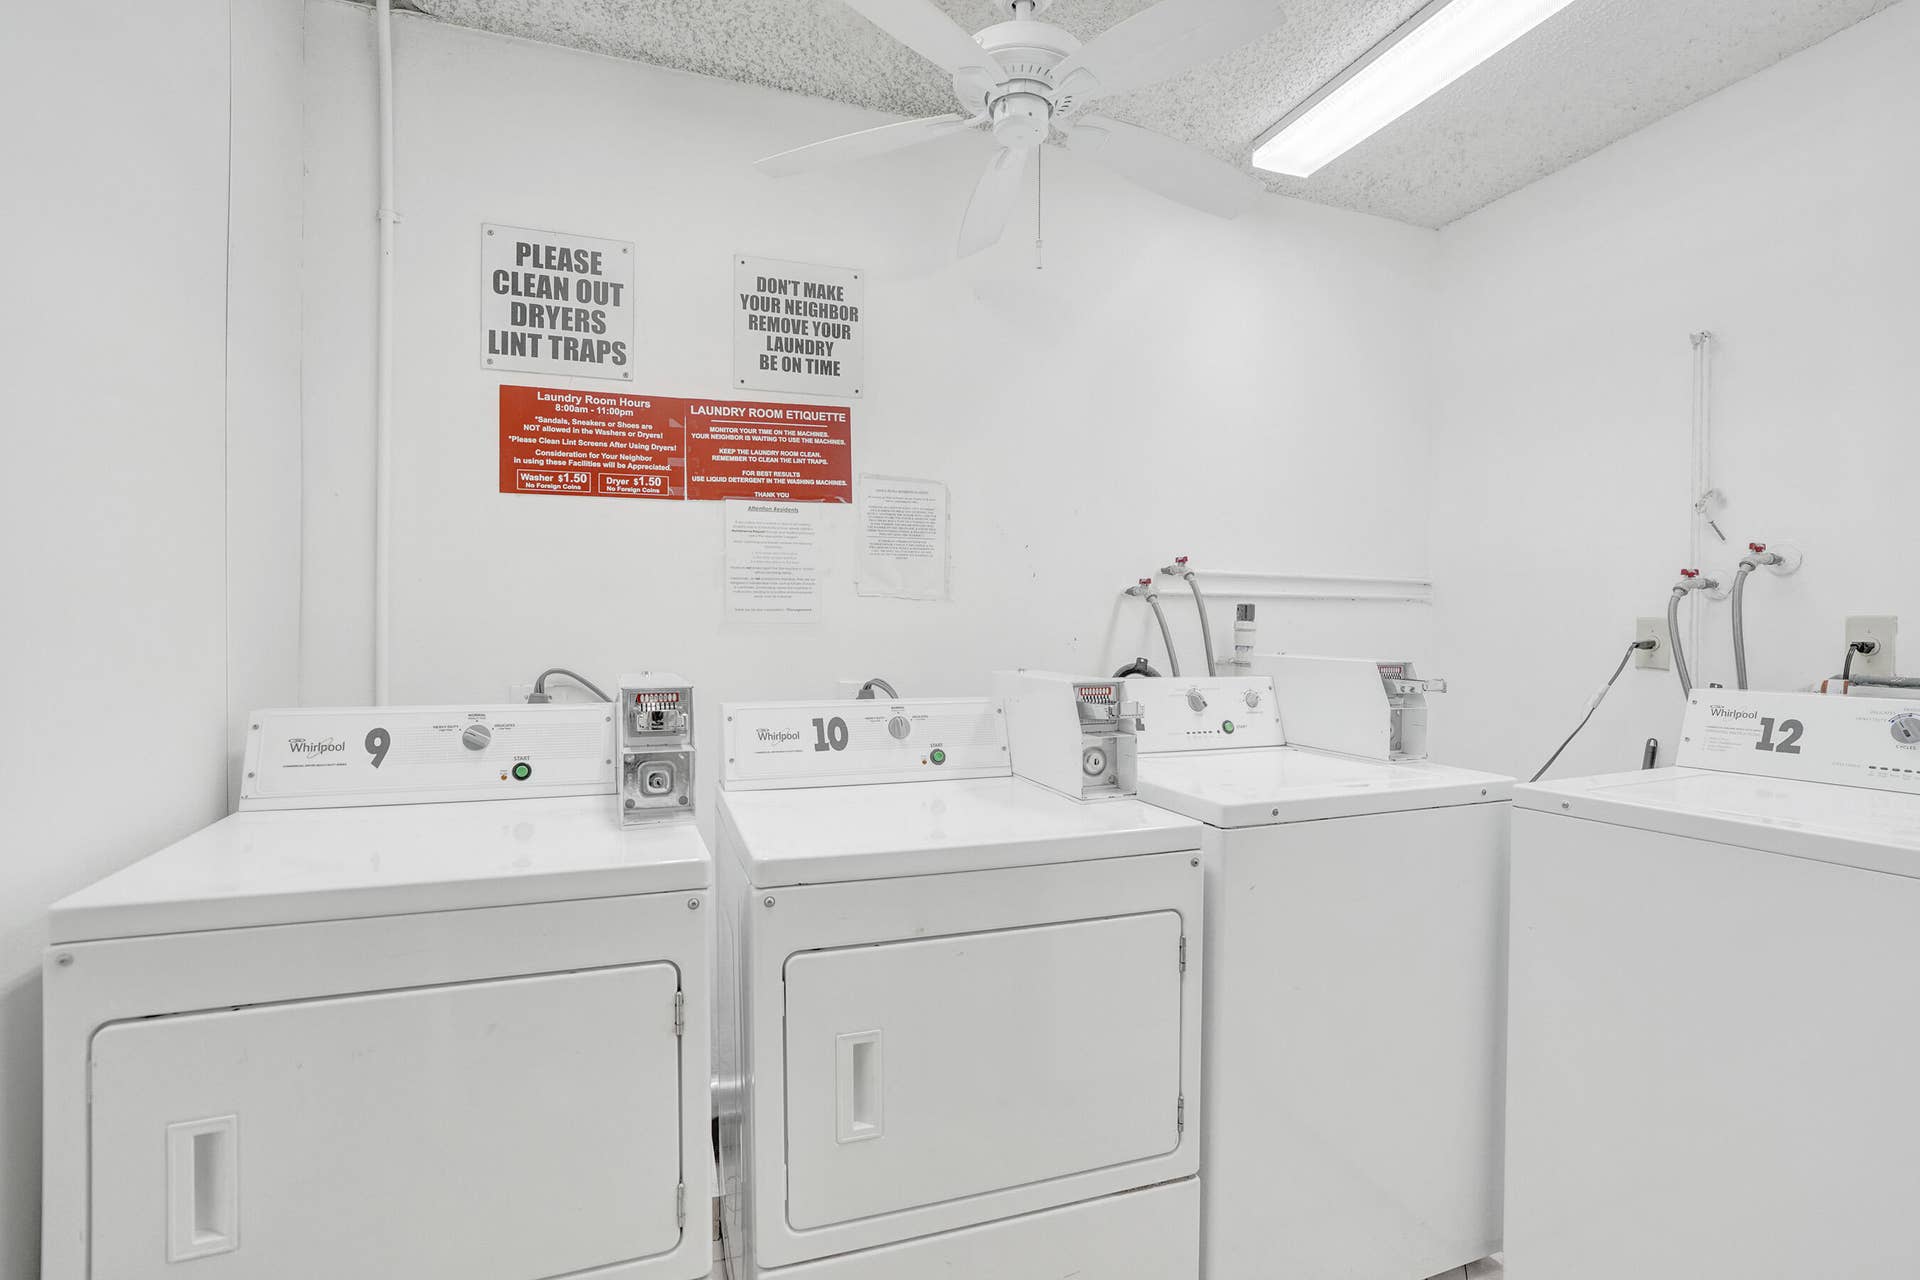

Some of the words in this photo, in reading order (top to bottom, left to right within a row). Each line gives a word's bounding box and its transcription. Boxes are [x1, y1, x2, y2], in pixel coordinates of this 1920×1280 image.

[516, 242, 602, 276] PLEASE
[492, 270, 569, 300] CLEAN
[576, 278, 624, 307] OUT
[756, 276, 800, 295] DON'T
[804, 283, 844, 301] MAKE
[740, 294, 781, 313] YOUR
[785, 298, 859, 322] NEIGHBOR
[511, 302, 606, 335] DRYERS
[748, 315, 809, 335] REMOVE
[813, 321, 851, 340] YOUR
[488, 329, 543, 358] LINT
[548, 335, 627, 366] TRAPS
[766, 335, 834, 357] LAUNDRY
[759, 355, 778, 371] BE
[781, 357, 802, 373] ON
[805, 357, 841, 377] TIME
[537, 392, 582, 405] Laundry
[585, 395, 616, 405] Room
[620, 398, 650, 408] Hours
[555, 404, 587, 413] 8:00am
[597, 407, 633, 416] 11:00pm
[691, 405, 746, 417] LAUNDRY
[749, 409, 783, 419] ROOM
[786, 411, 846, 422] ETIQUETTE
[542, 425, 570, 433] allowed
[637, 431, 663, 439] Dryers!
[572, 418, 606, 427] Sneakers
[618, 420, 639, 429] Shoes
[539, 437, 560, 445] Clean
[562, 438, 576, 446] Lint
[578, 439, 607, 448] Screens
[629, 442, 649, 451] Using
[535, 449, 587, 458] Consideration
[620, 453, 652, 462] Neighbor
[523, 458, 544, 466] using
[627, 463, 671, 471] Appreciated.
[558, 473, 586, 483] $1.50
[606, 477, 629, 485] Dryer
[634, 477, 661, 486] $1.50
[1710, 708, 1758, 720] Whirlpool
[757, 731, 800, 742] Whirlpool
[812, 715, 849, 752] 10
[1755, 716, 1804, 754] 12
[289, 741, 346, 755] Whirlpool
[365, 728, 391, 768] 9
